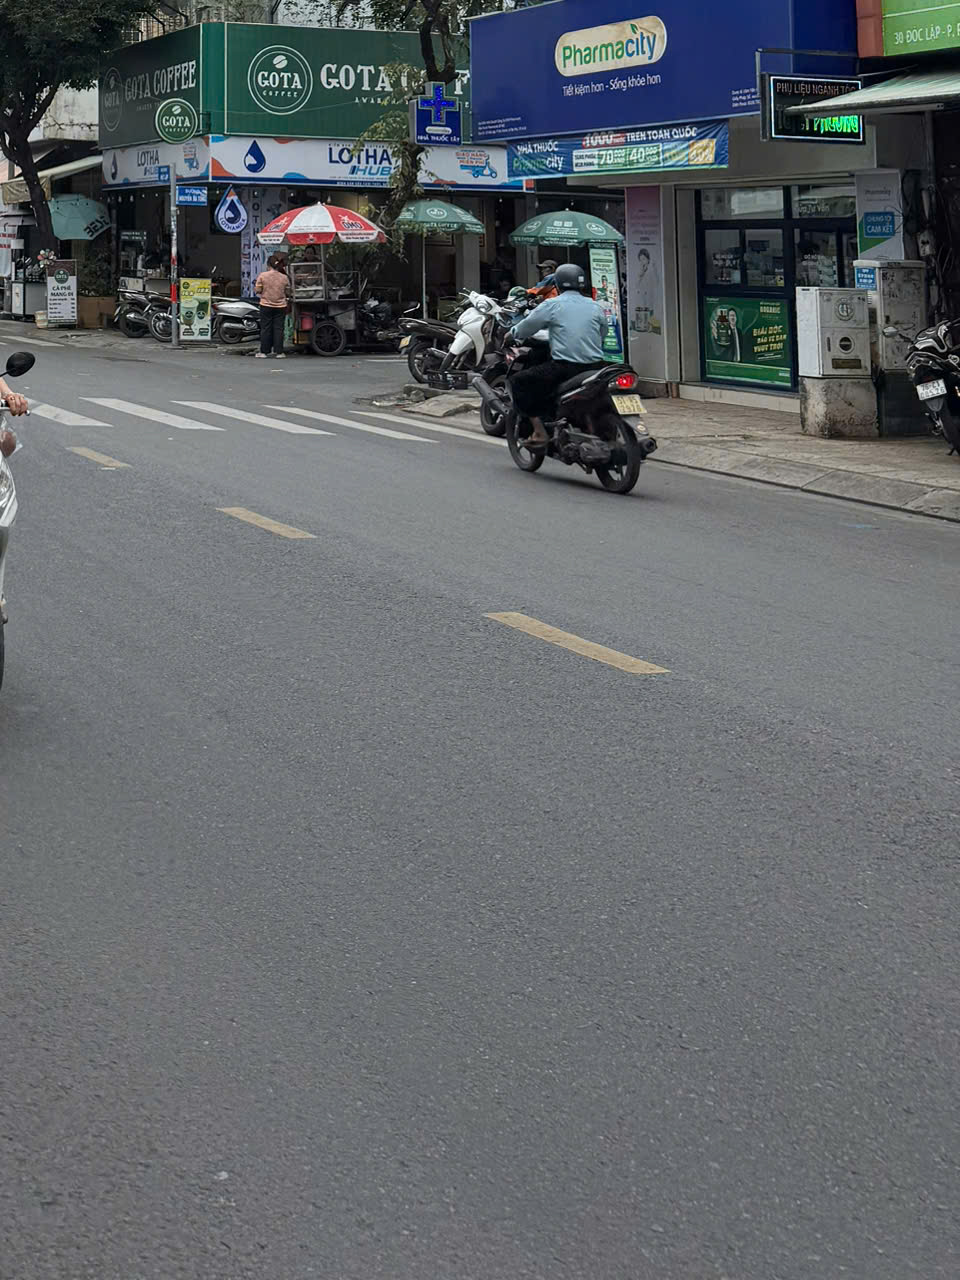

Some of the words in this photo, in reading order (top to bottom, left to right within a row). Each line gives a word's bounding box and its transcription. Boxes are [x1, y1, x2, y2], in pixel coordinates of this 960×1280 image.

[562, 25, 657, 69] Pharmacity
[125, 73, 151, 102] GOTA
[153, 60, 197, 95] COFFEE
[258, 71, 303, 89] GOTA
[320, 63, 393, 91] GOTA
[609, 77, 627, 91] Sống
[776, 82, 792, 96] PHỤ
[794, 82, 811, 96] LIỆU
[162, 115, 191, 127] GOTA
[533, 141, 559, 152] THUỐC
[137, 149, 160, 167] LOTHA
[328, 147, 393, 165] LOTHA
